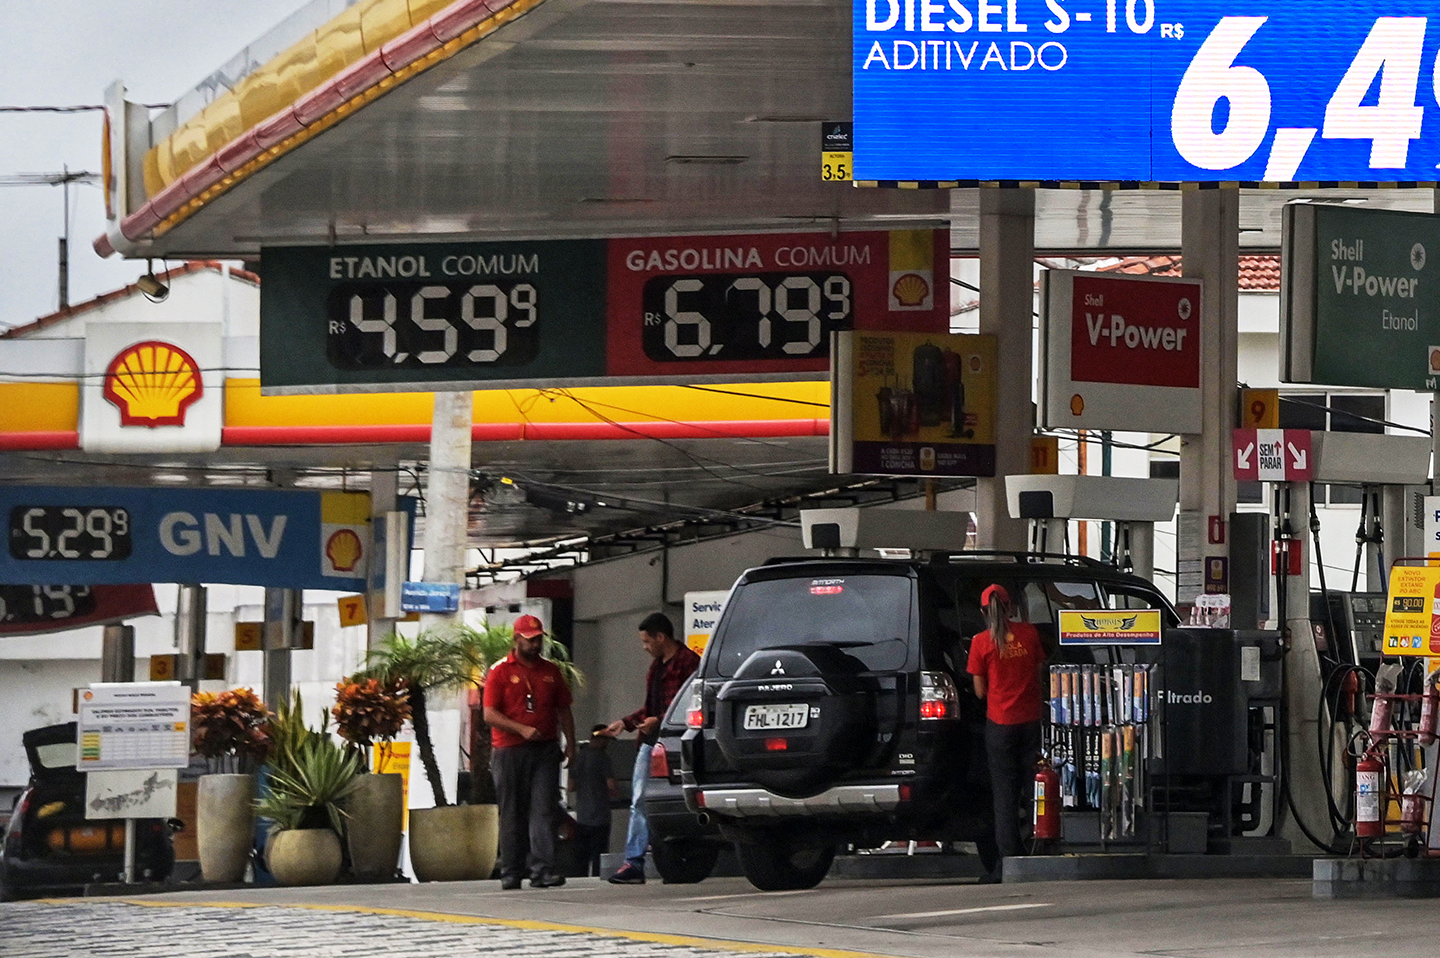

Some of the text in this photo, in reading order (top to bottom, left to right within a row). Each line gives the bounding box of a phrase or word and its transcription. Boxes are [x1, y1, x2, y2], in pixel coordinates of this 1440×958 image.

[1160, 23, 1185, 40] R$
[862, 40, 1068, 71] ADITIVADO
[823, 164, 846, 180] 3,5
[1331, 238, 1364, 261] Shell
[329, 254, 539, 279] ETANOL COMUM
[626, 245, 871, 272] GASOLINA COMUM
[1331, 265, 1419, 298] V-Power
[1084, 294, 1104, 307] Shell
[644, 312, 662, 326] R$
[1382, 308, 1419, 331] Etanol
[329, 320, 346, 335] R$
[1085, 312, 1187, 351] V-Power
[1251, 400, 1266, 422] 9
[1259, 443, 1274, 456] SEM
[1259, 457, 1282, 469] PARAR
[159, 511, 288, 559] GNV
[347, 604, 358, 620] 7
[157, 660, 167, 675] 3
[757, 684, 793, 692] PAJERO
[1157, 690, 1213, 704] Fltrado
